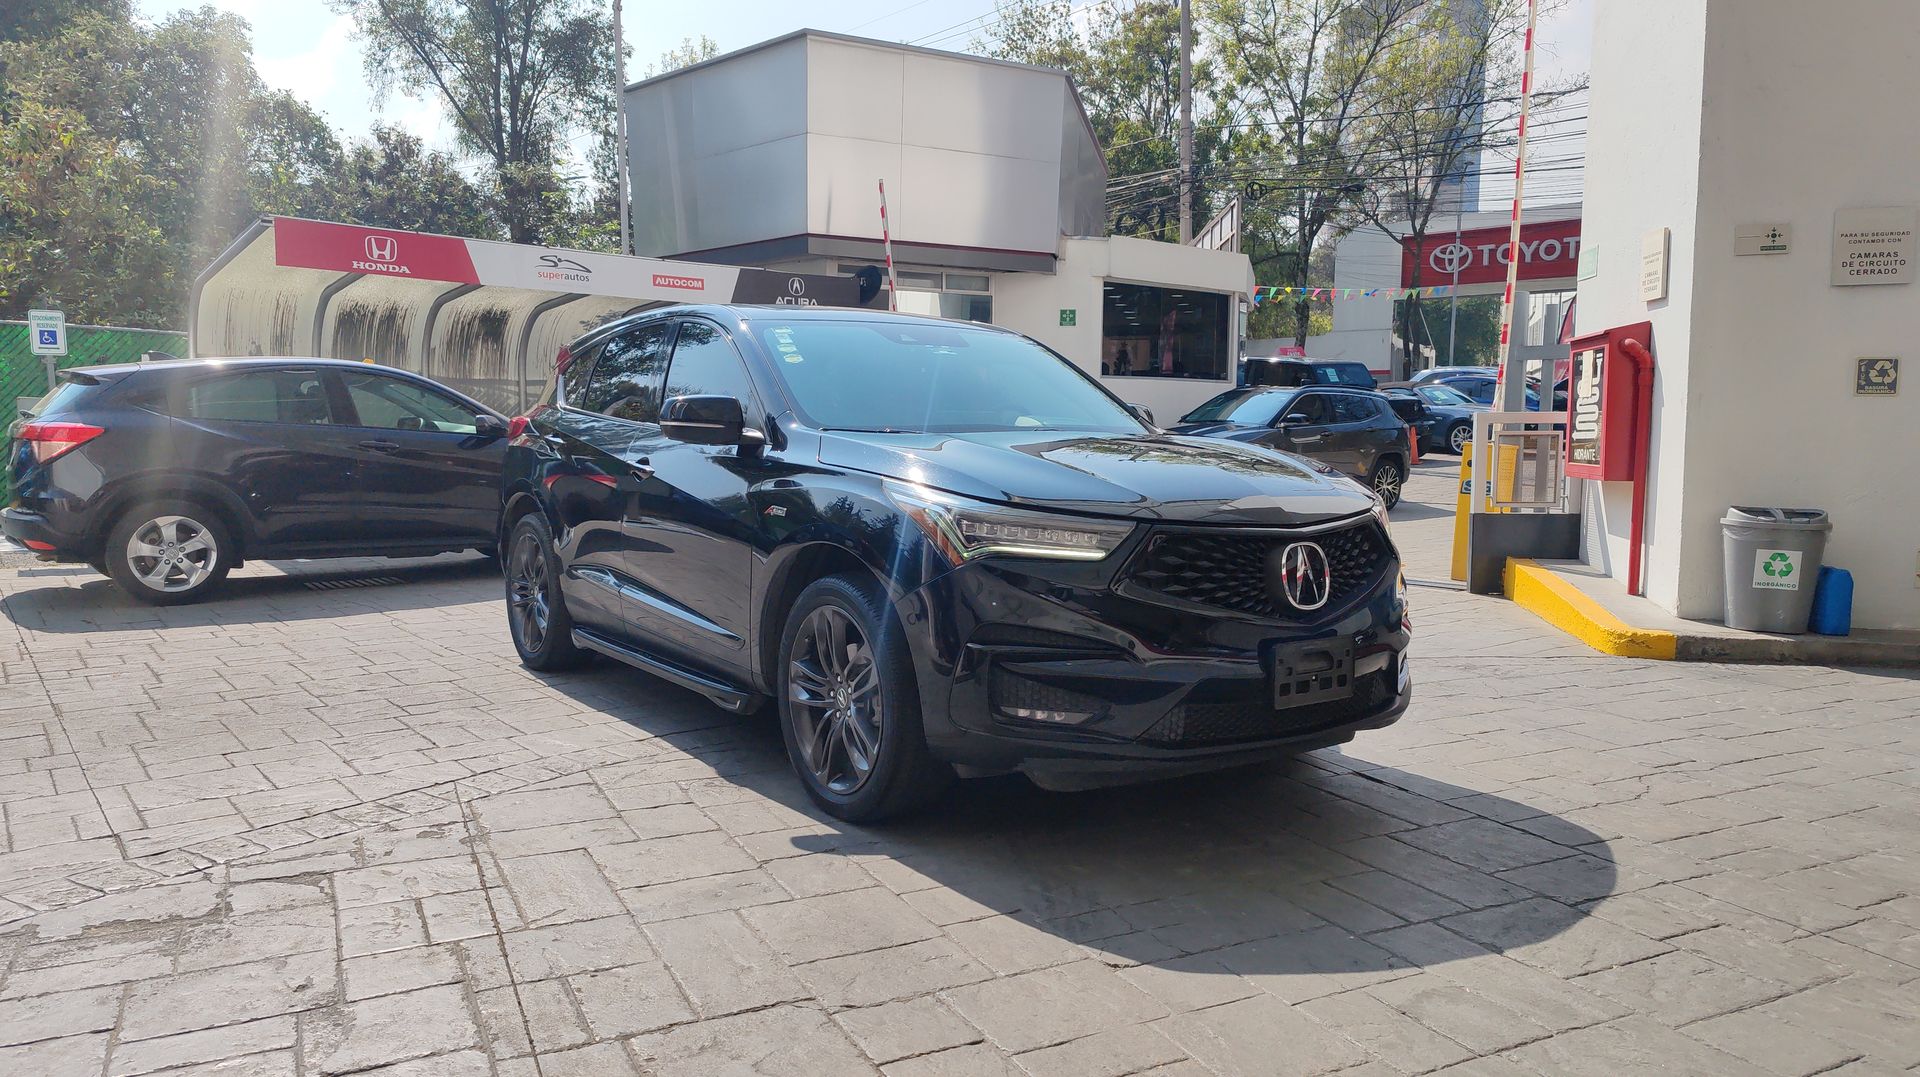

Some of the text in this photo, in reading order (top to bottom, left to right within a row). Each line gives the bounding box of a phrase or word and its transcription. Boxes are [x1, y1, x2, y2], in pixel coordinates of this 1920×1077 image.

[1849, 251, 1899, 259] CAMARAS
[352, 260, 411, 274] HONDA
[1858, 259, 1906, 268] CIRCUITO
[537, 271, 590, 282] superautos
[1849, 268, 1898, 276] CERRADO
[655, 276, 702, 288] AUTOCOM
[775, 296, 818, 306] ACURA
[1574, 449, 1595, 460] HIDRANTE
